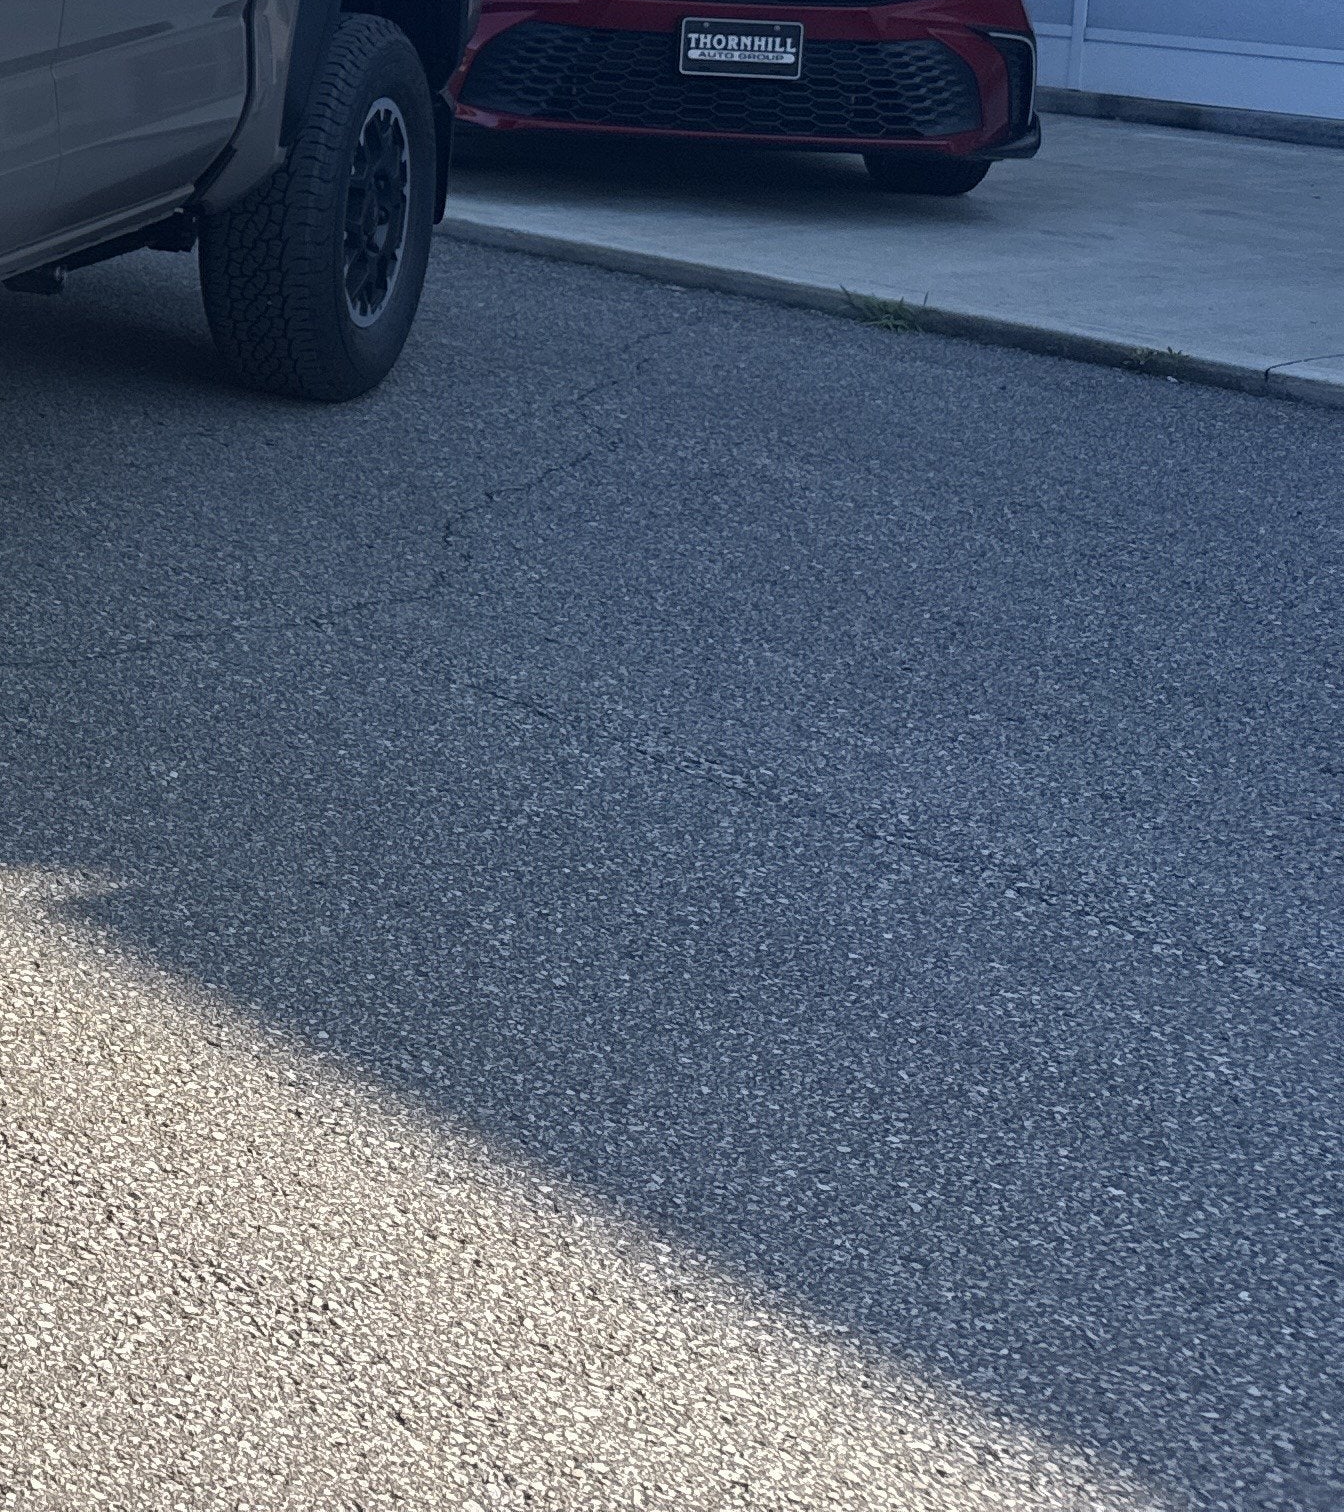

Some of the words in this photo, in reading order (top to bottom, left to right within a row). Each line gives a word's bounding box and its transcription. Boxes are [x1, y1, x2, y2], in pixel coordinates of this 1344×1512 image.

[687, 33, 797, 53] THORNHILL
[698, 50, 735, 59] AUTO
[738, 52, 785, 61] GROUP
